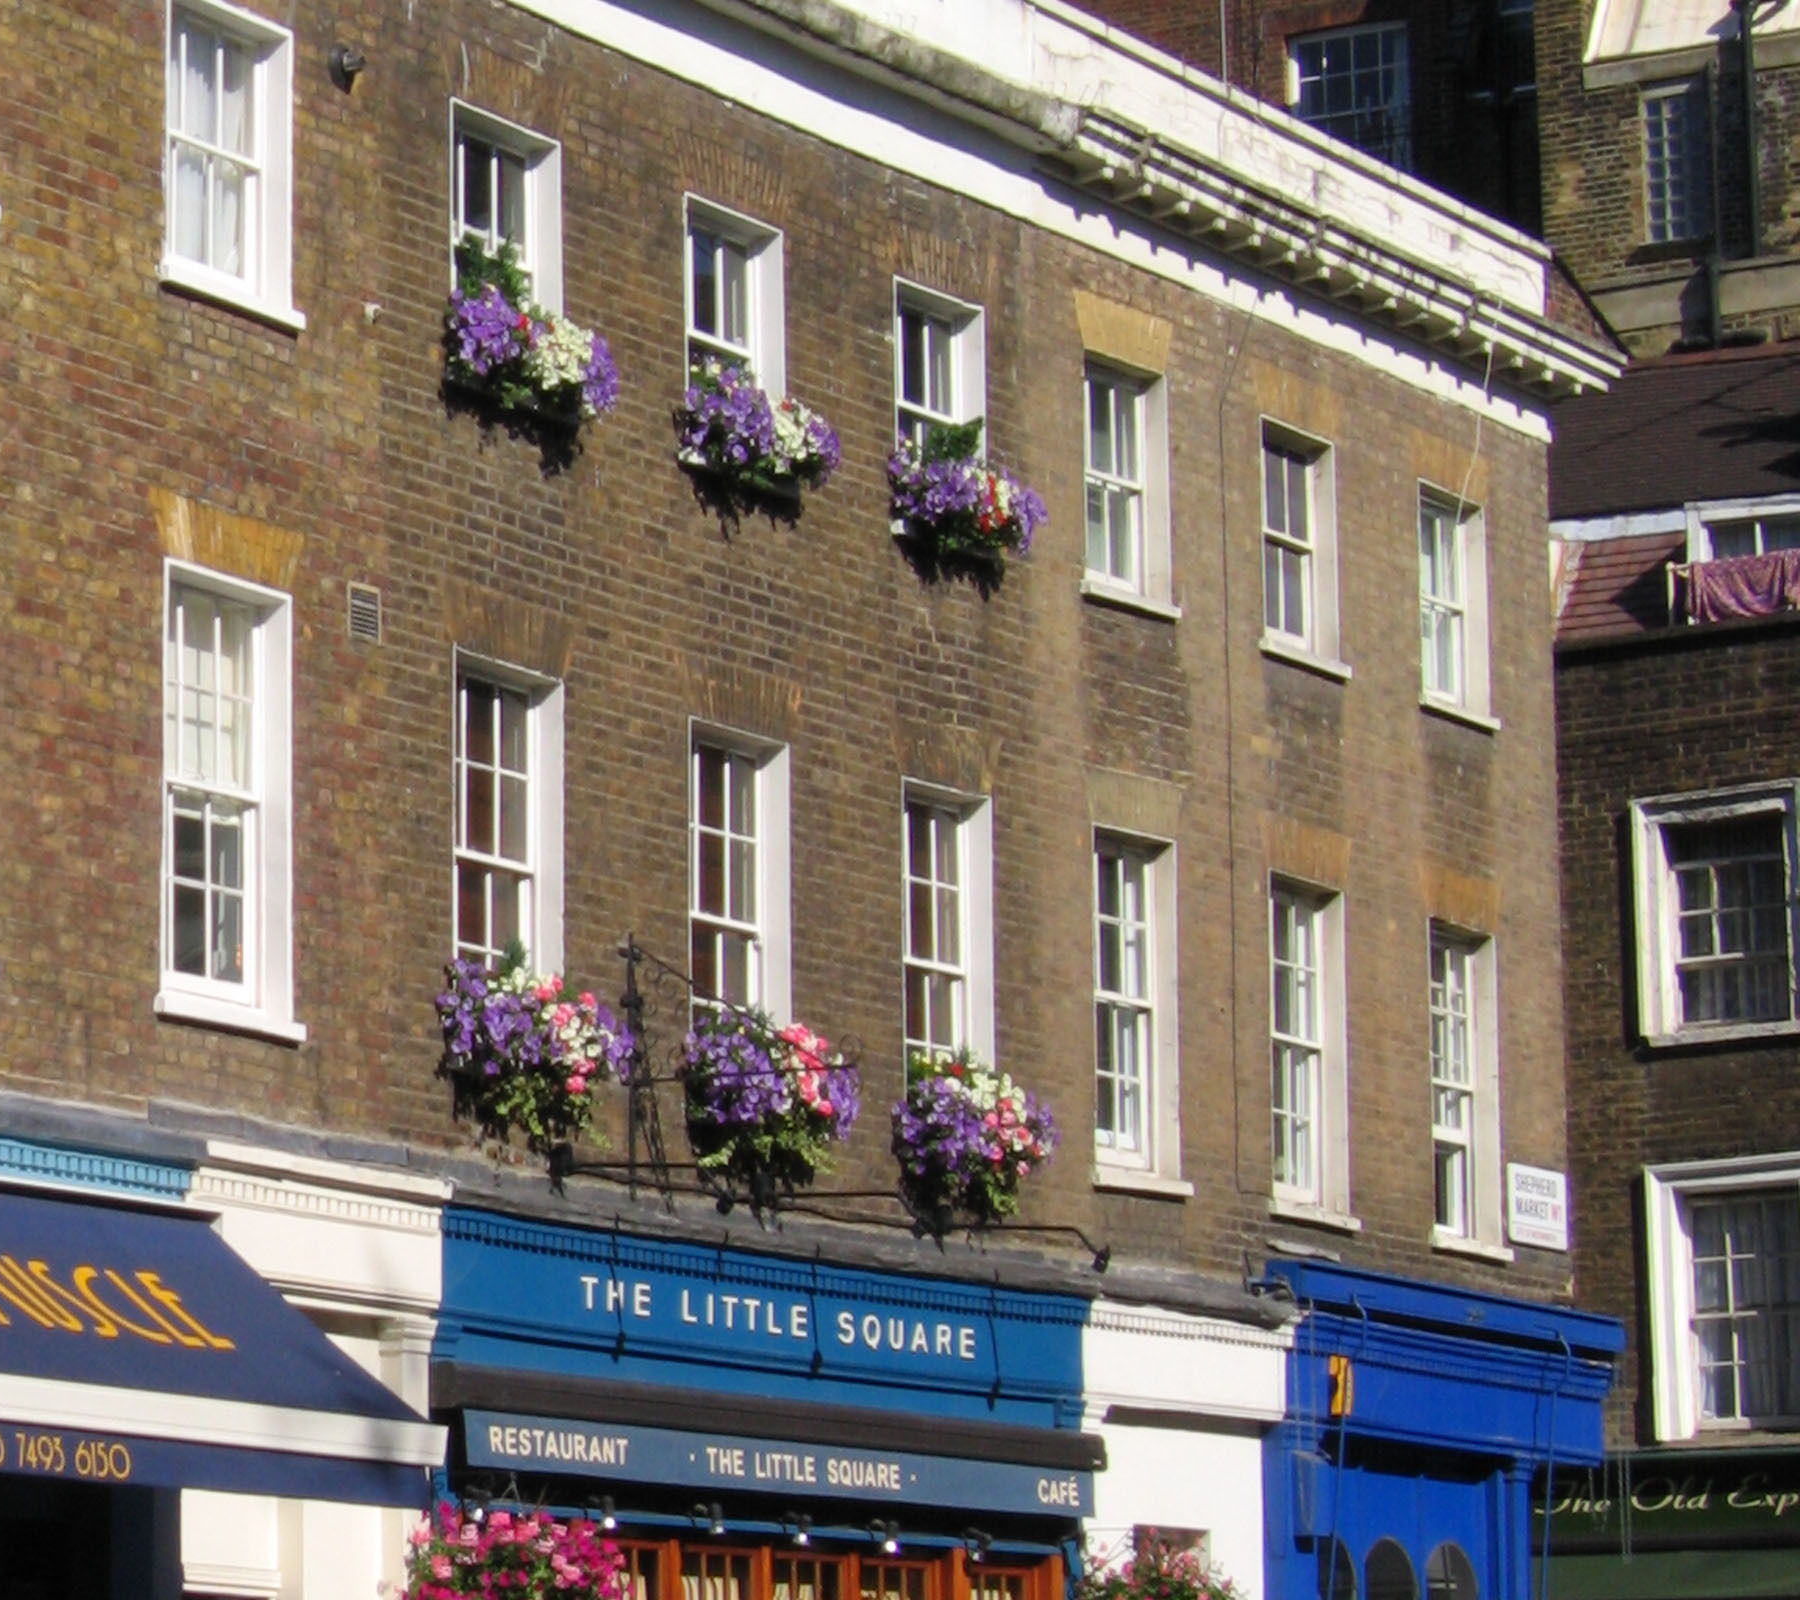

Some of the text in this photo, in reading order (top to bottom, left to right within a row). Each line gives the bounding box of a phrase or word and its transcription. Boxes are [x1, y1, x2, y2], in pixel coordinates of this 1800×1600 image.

[579, 1275, 978, 1360] THE LITTLE SQUARE
[15, 1430, 66, 1476] 7493
[74, 1437, 131, 1481] 6150
[488, 1425, 628, 1467] RESTAURANT
[707, 1446, 901, 1491] THE LITTLE SQUARE
[1037, 1474, 1080, 1508] CAFÉ
[1630, 1476, 1714, 1512] Old
